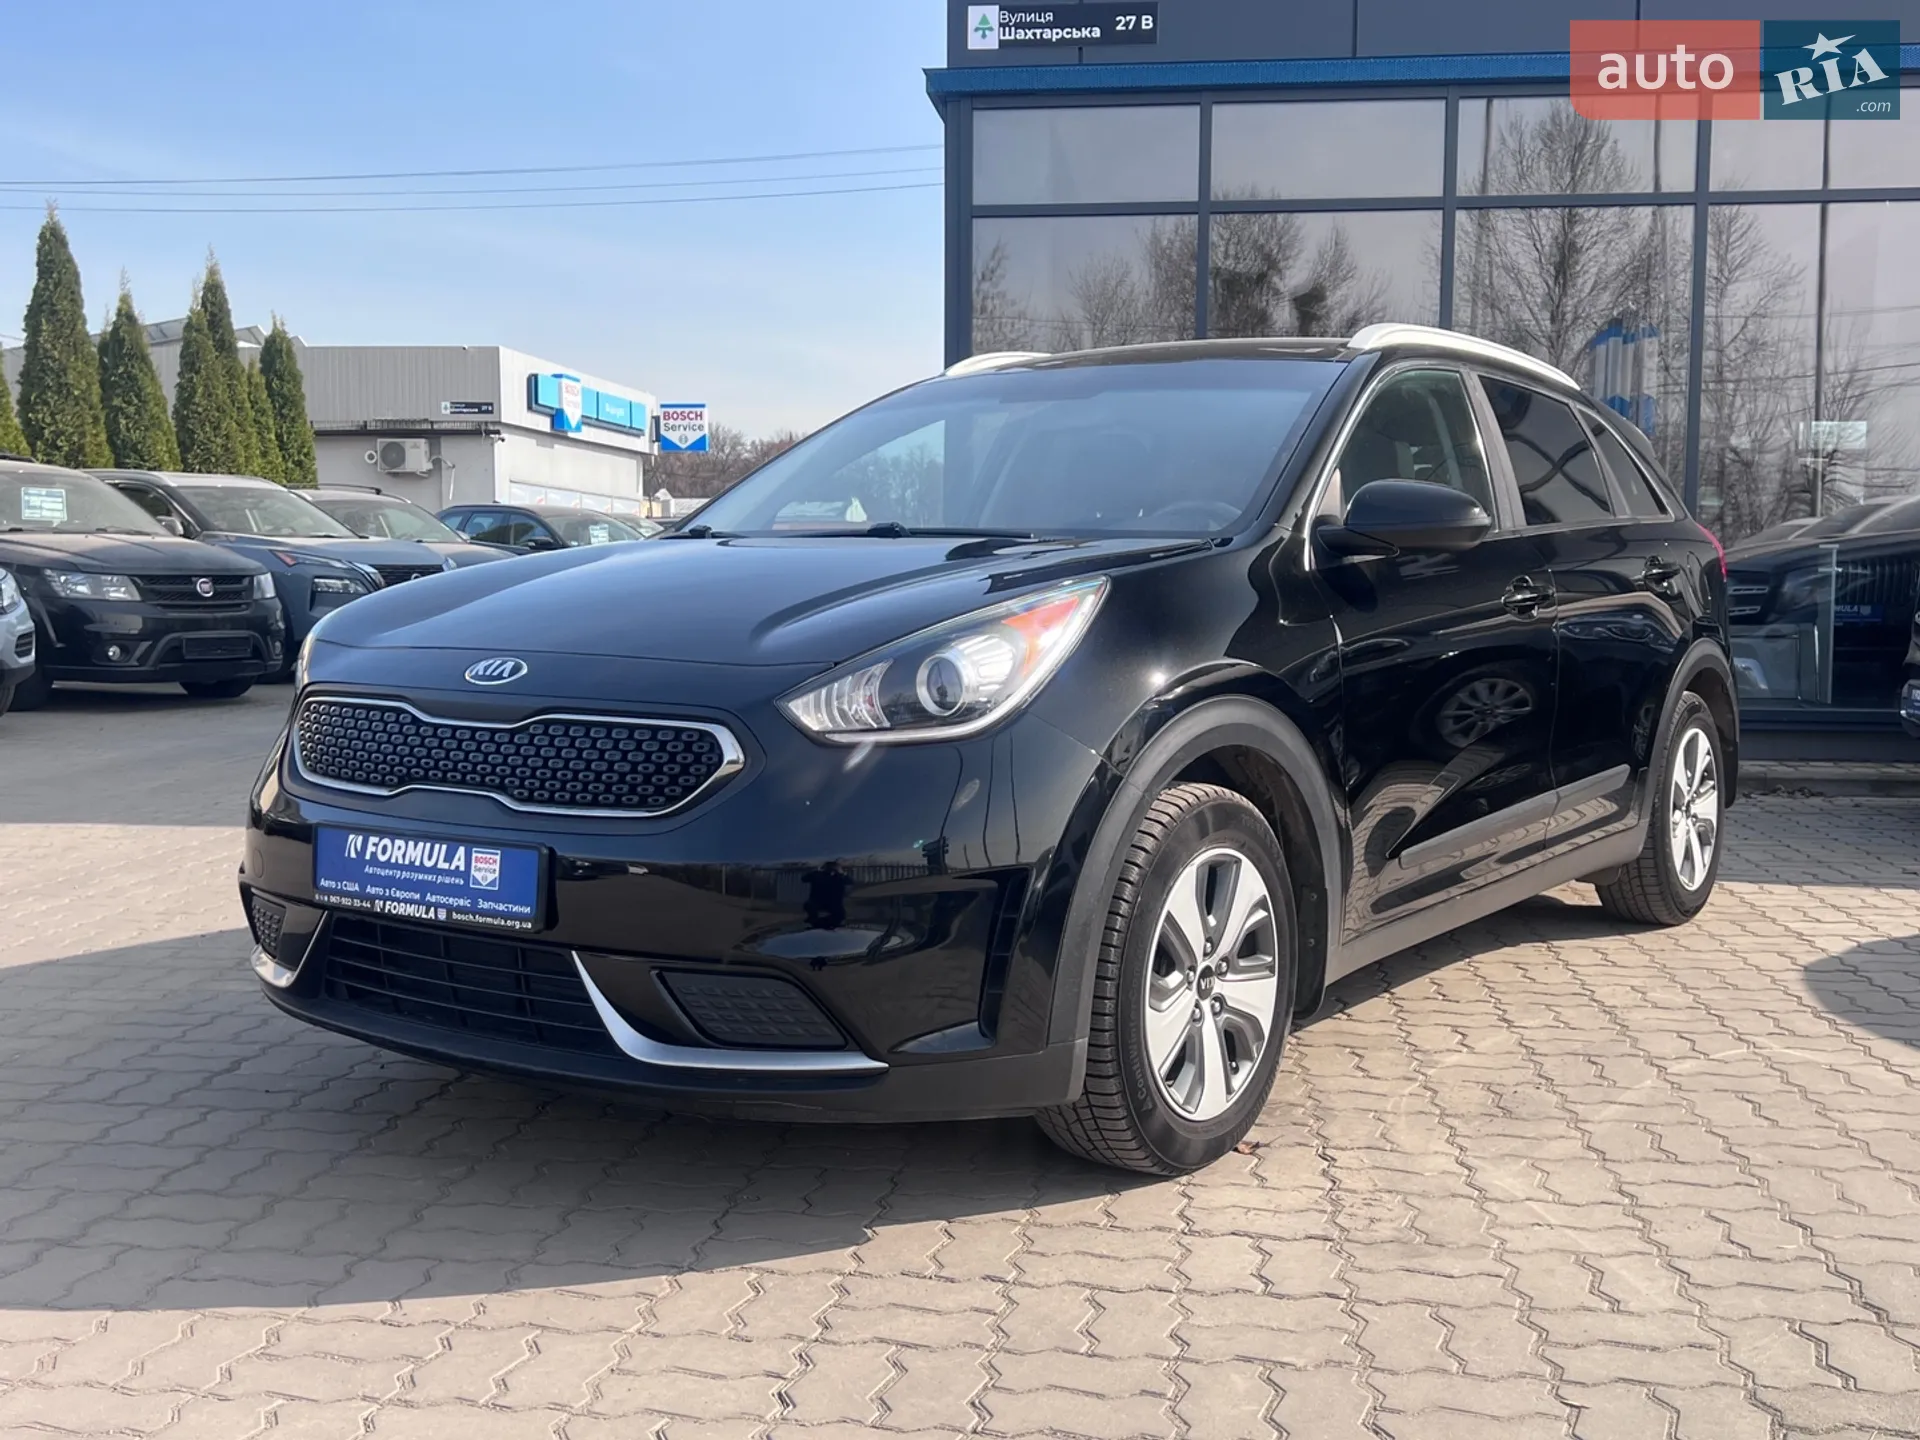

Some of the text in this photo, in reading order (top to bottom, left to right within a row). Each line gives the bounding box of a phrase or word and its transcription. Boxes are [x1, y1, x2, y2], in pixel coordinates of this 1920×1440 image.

[999, 11, 1054, 25] Вулиця
[1115, 15, 1154, 30] 27 В
[998, 26, 1101, 42] Шахтарська
[662, 410, 703, 421] BOSCH
[663, 421, 705, 432] Service
[471, 660, 515, 677] KIA
[365, 836, 465, 871] FORMULA
[474, 855, 498, 866] BOSCH
[364, 864, 465, 886] Автоцентр розумних рішень
[473, 864, 498, 875] Service
[319, 877, 337, 889] Авто
[342, 880, 360, 892] США
[365, 884, 384, 896] Авто
[390, 887, 421, 901] Європи
[425, 892, 472, 908] Автосервіс
[477, 898, 532, 914] Запчастини
[385, 900, 436, 920] FORMULA
[452, 911, 533, 929] bosch.formula.org.ua
